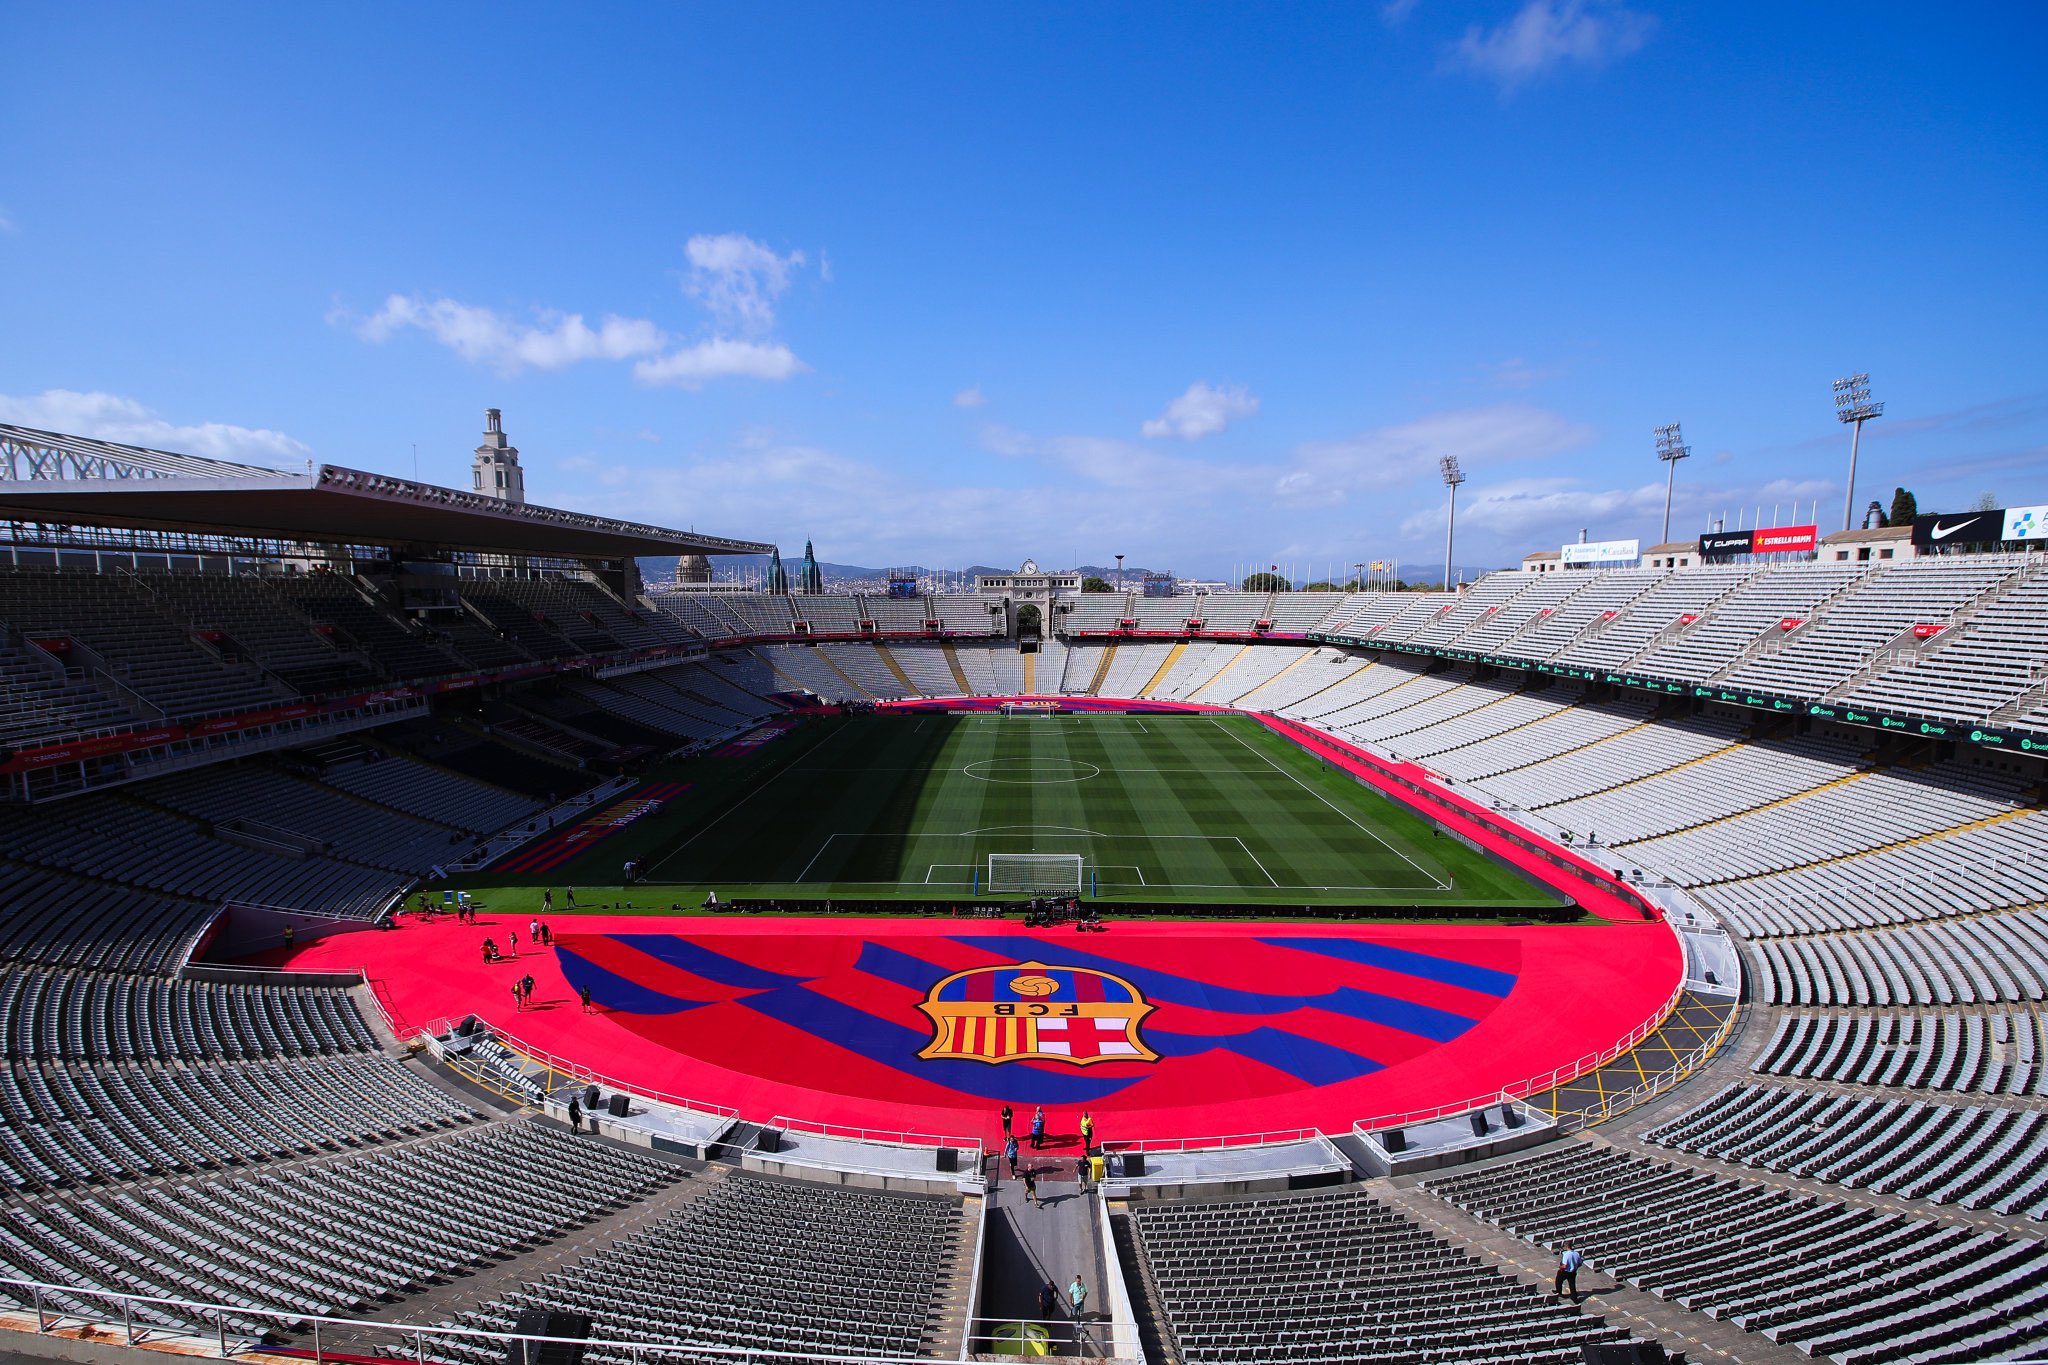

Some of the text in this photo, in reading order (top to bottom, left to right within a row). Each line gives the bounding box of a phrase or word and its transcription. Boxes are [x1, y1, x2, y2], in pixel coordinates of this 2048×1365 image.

[1714, 538, 1749, 548] CUPRA
[1764, 535, 1812, 545] ESTRELLA DAMM
[1819, 708, 1835, 717] Spotify
[1854, 713, 1869, 722] Spotify
[1890, 719, 1906, 728] Spotify
[1929, 725, 1947, 735] Spotify
[1982, 733, 2004, 744] Spotify
[994, 1004, 1079, 1016] FCB
